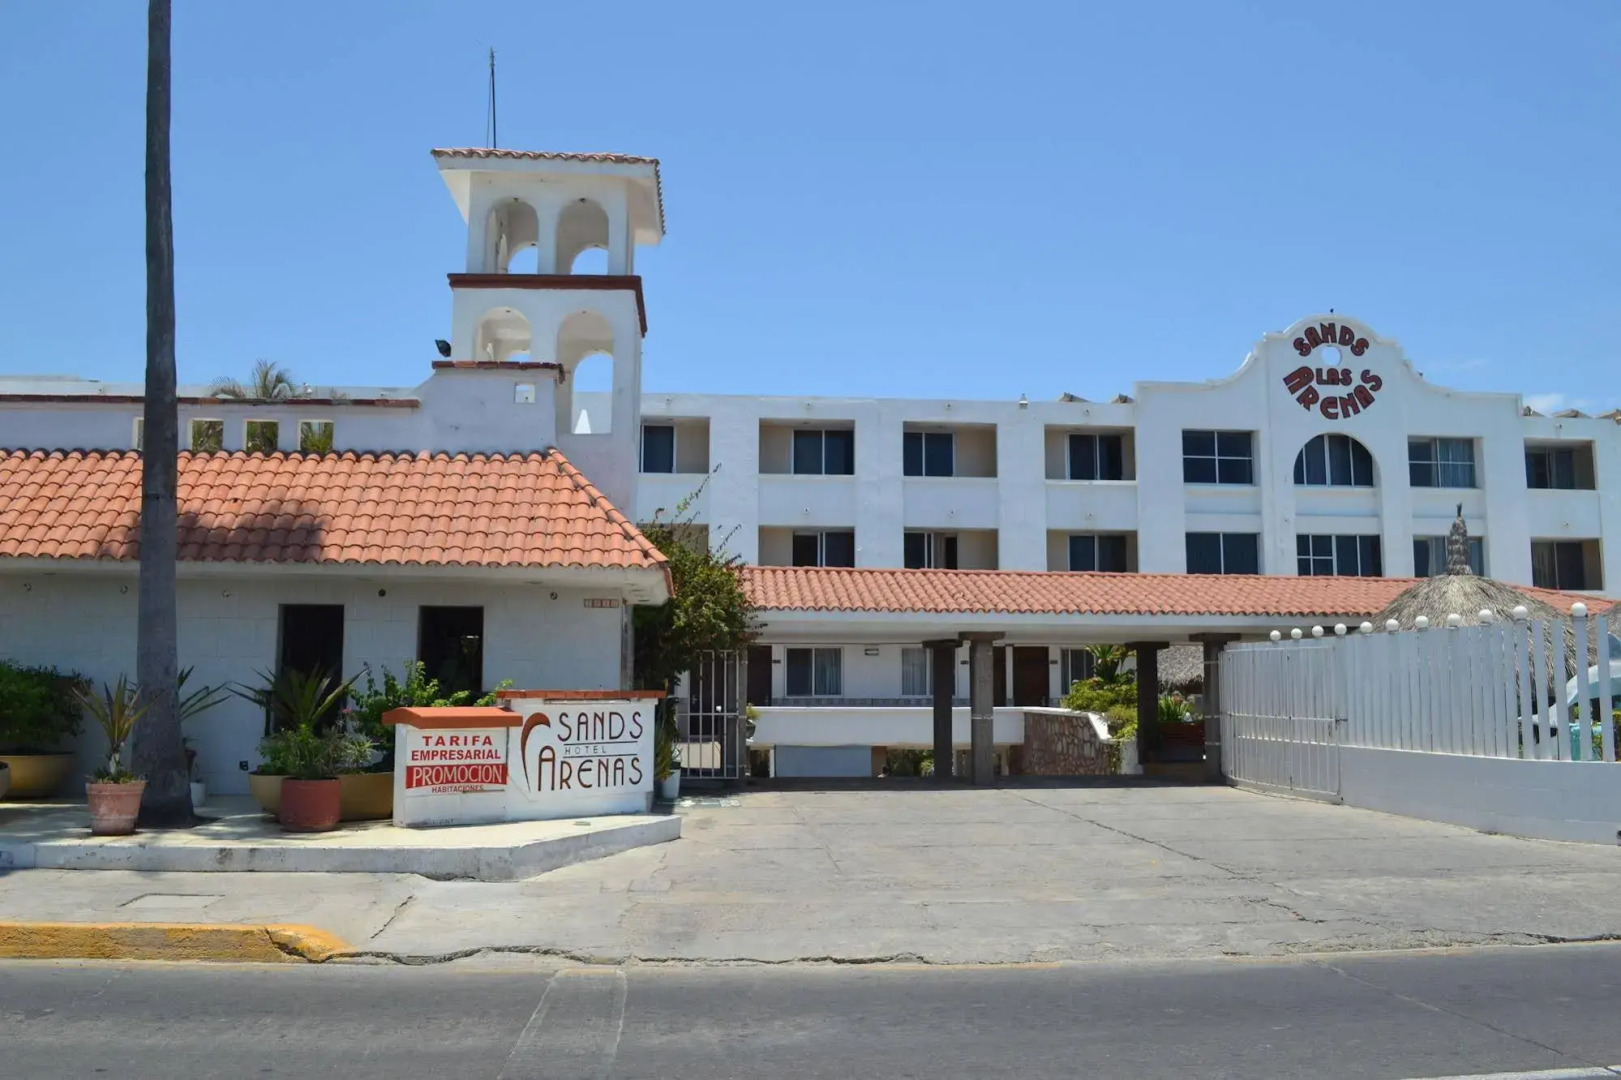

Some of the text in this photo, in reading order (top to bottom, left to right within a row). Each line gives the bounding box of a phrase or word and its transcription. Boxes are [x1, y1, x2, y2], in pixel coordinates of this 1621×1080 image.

[1293, 322, 1369, 357] SANDS
[1315, 367, 1352, 386] LAS
[1283, 366, 1382, 420] ARENAS
[557, 711, 643, 741] SANDS
[422, 735, 492, 747] TARIFA
[565, 745, 607, 755] HOTEL
[411, 749, 501, 761] EMPRESARIAL
[538, 745, 643, 792] ARENAS
[431, 784, 484, 794] HABITACIONES
